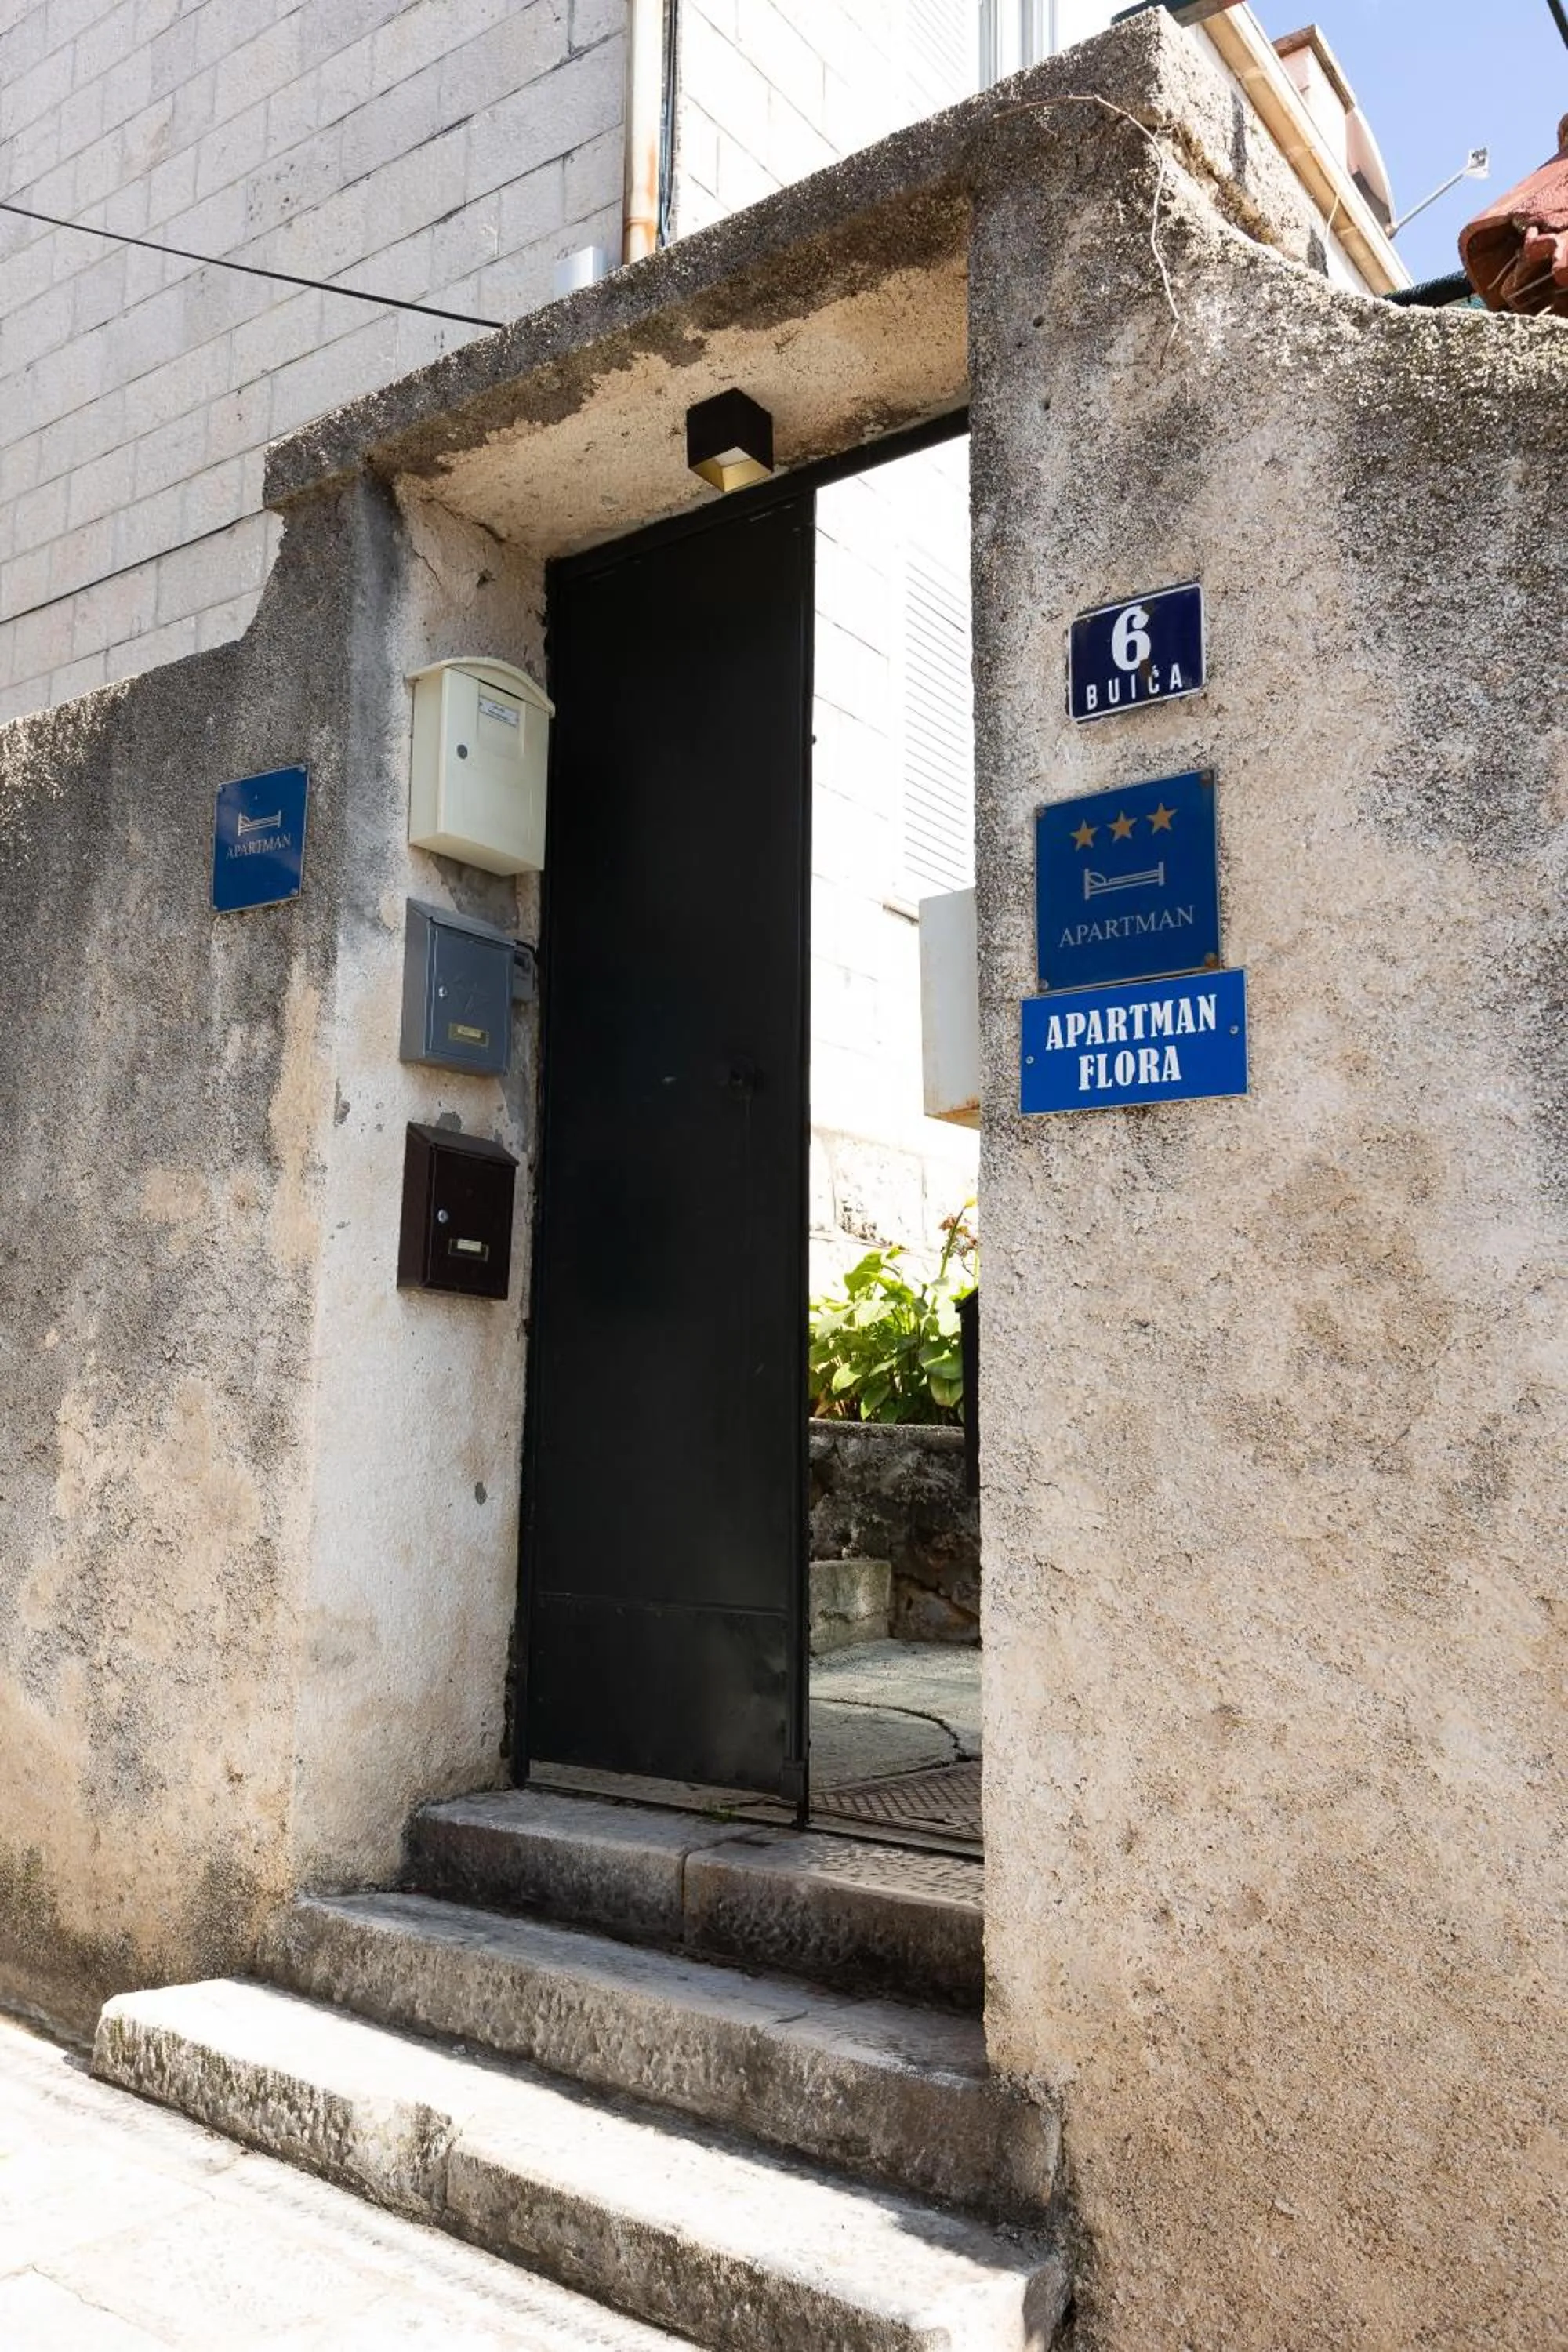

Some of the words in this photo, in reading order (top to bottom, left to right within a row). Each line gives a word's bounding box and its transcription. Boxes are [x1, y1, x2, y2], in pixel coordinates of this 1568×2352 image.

[1112, 605, 1151, 671] 6
[226, 833, 291, 860] APARTMAN
[1059, 905, 1196, 948] APARTMAN
[1045, 994, 1217, 1051] APARTMAN
[1078, 1045, 1182, 1091] FLORA
